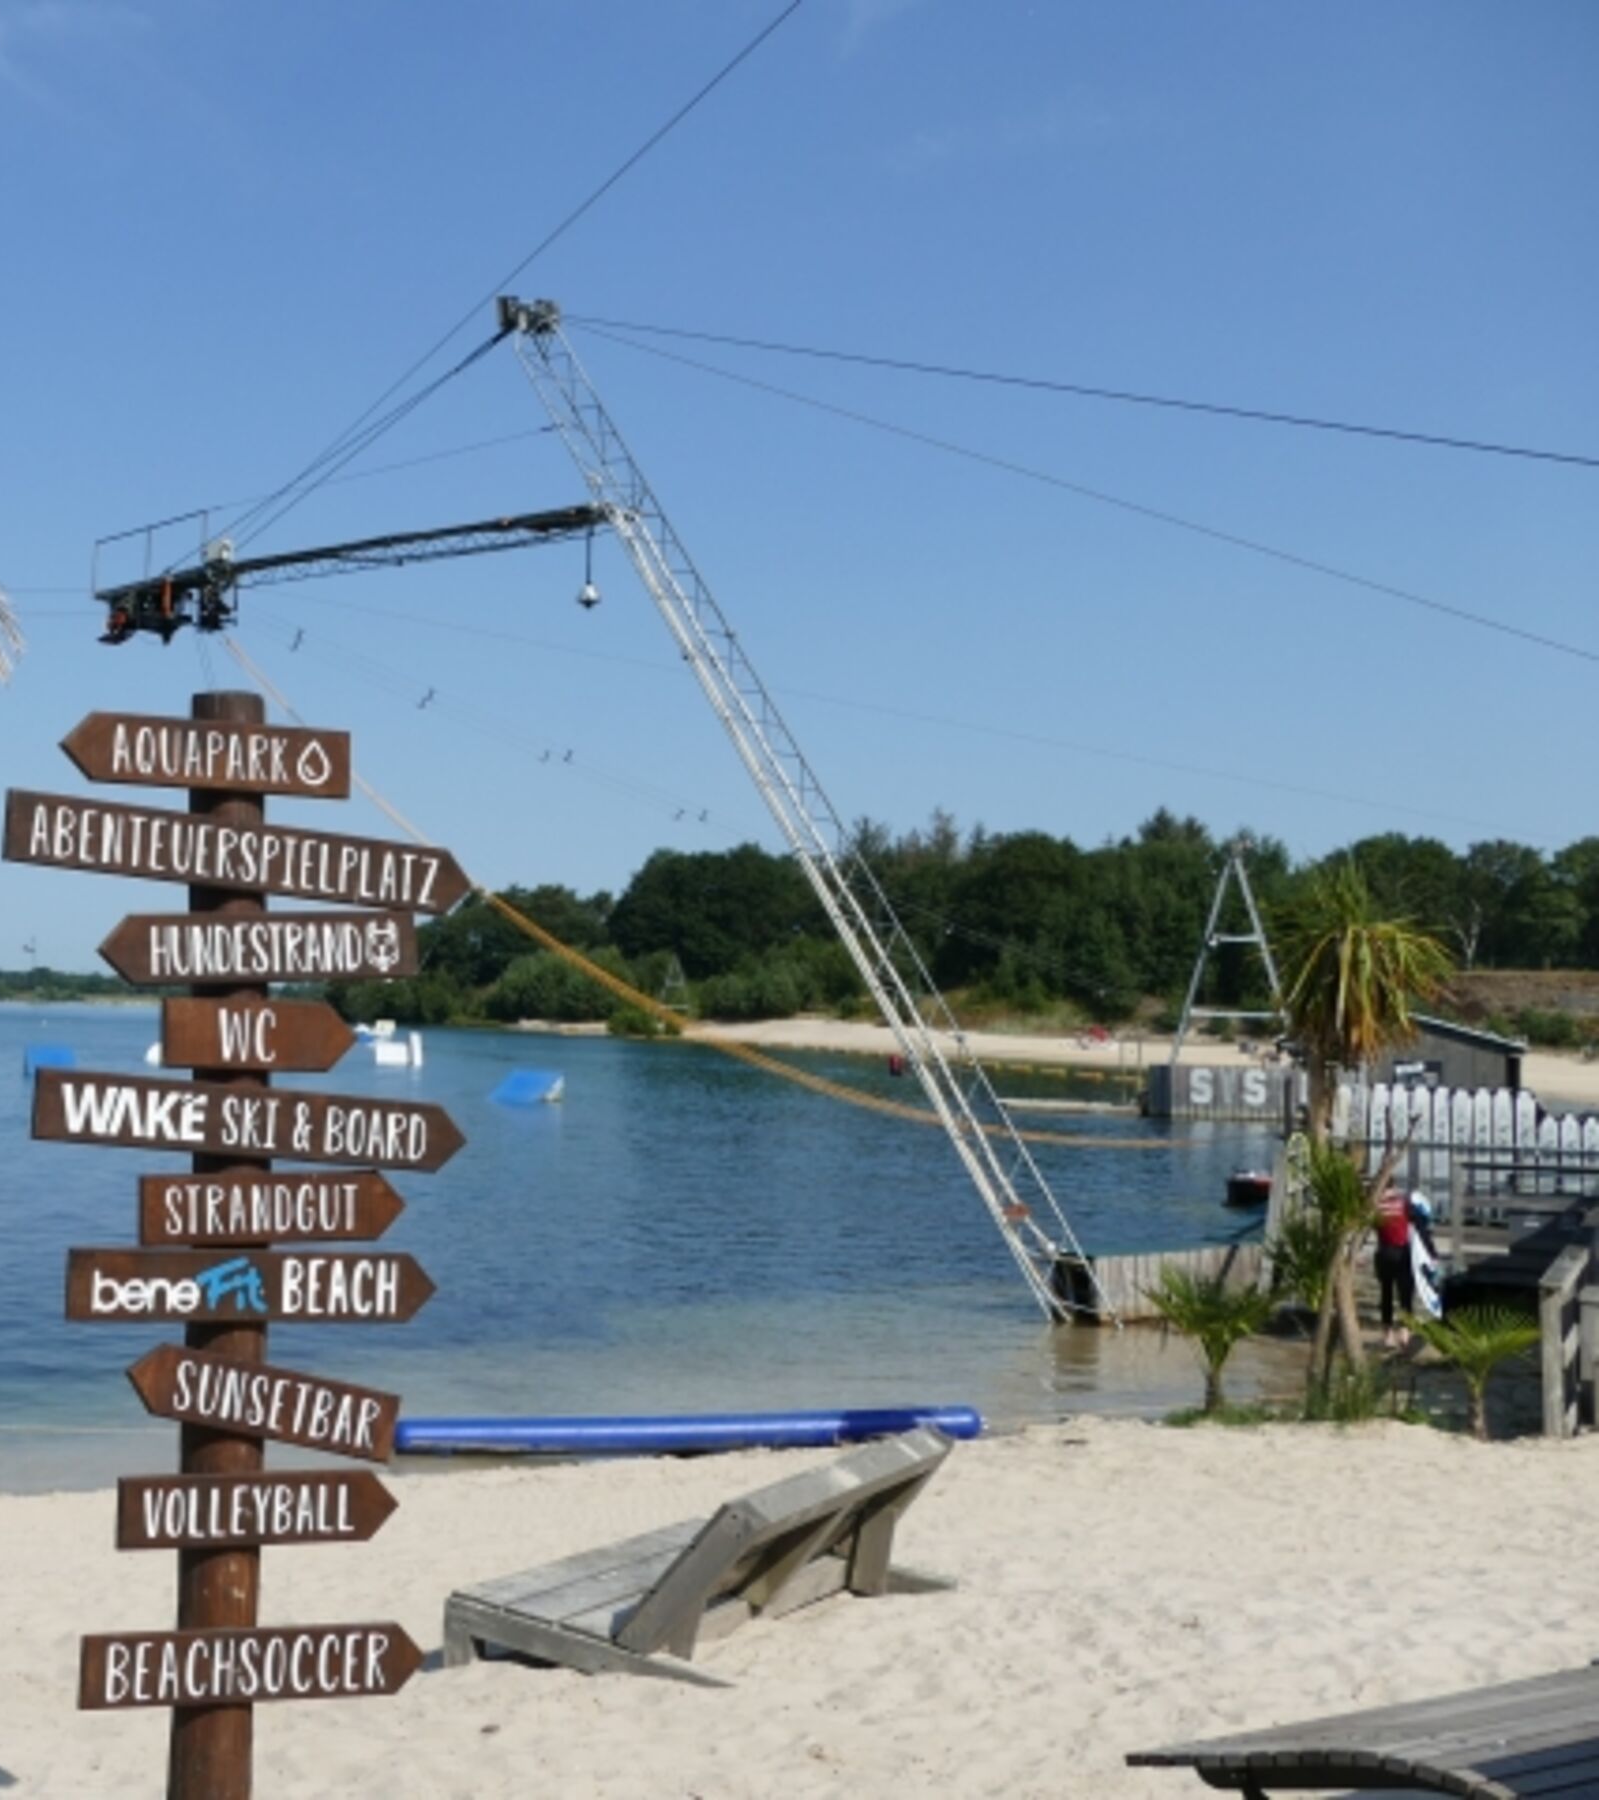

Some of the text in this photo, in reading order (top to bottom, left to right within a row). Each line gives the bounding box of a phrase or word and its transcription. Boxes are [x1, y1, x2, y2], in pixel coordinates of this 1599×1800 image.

[111, 722, 289, 784] AQUAPARK
[29, 803, 440, 906] ABENTEUERSPIELPLATZ
[150, 921, 362, 976] HUNDESTRAND
[218, 1007, 276, 1063] WC
[61, 1082, 427, 1161] WAKE SKI & BOARD
[164, 1183, 358, 1236] STRANDGUT
[281, 1257, 398, 1316] BEACH
[173, 1360, 381, 1448] SUNSETBAR
[143, 1484, 354, 1539] VOLLEYBALL
[105, 1632, 389, 1703] BEACHSOCCER
